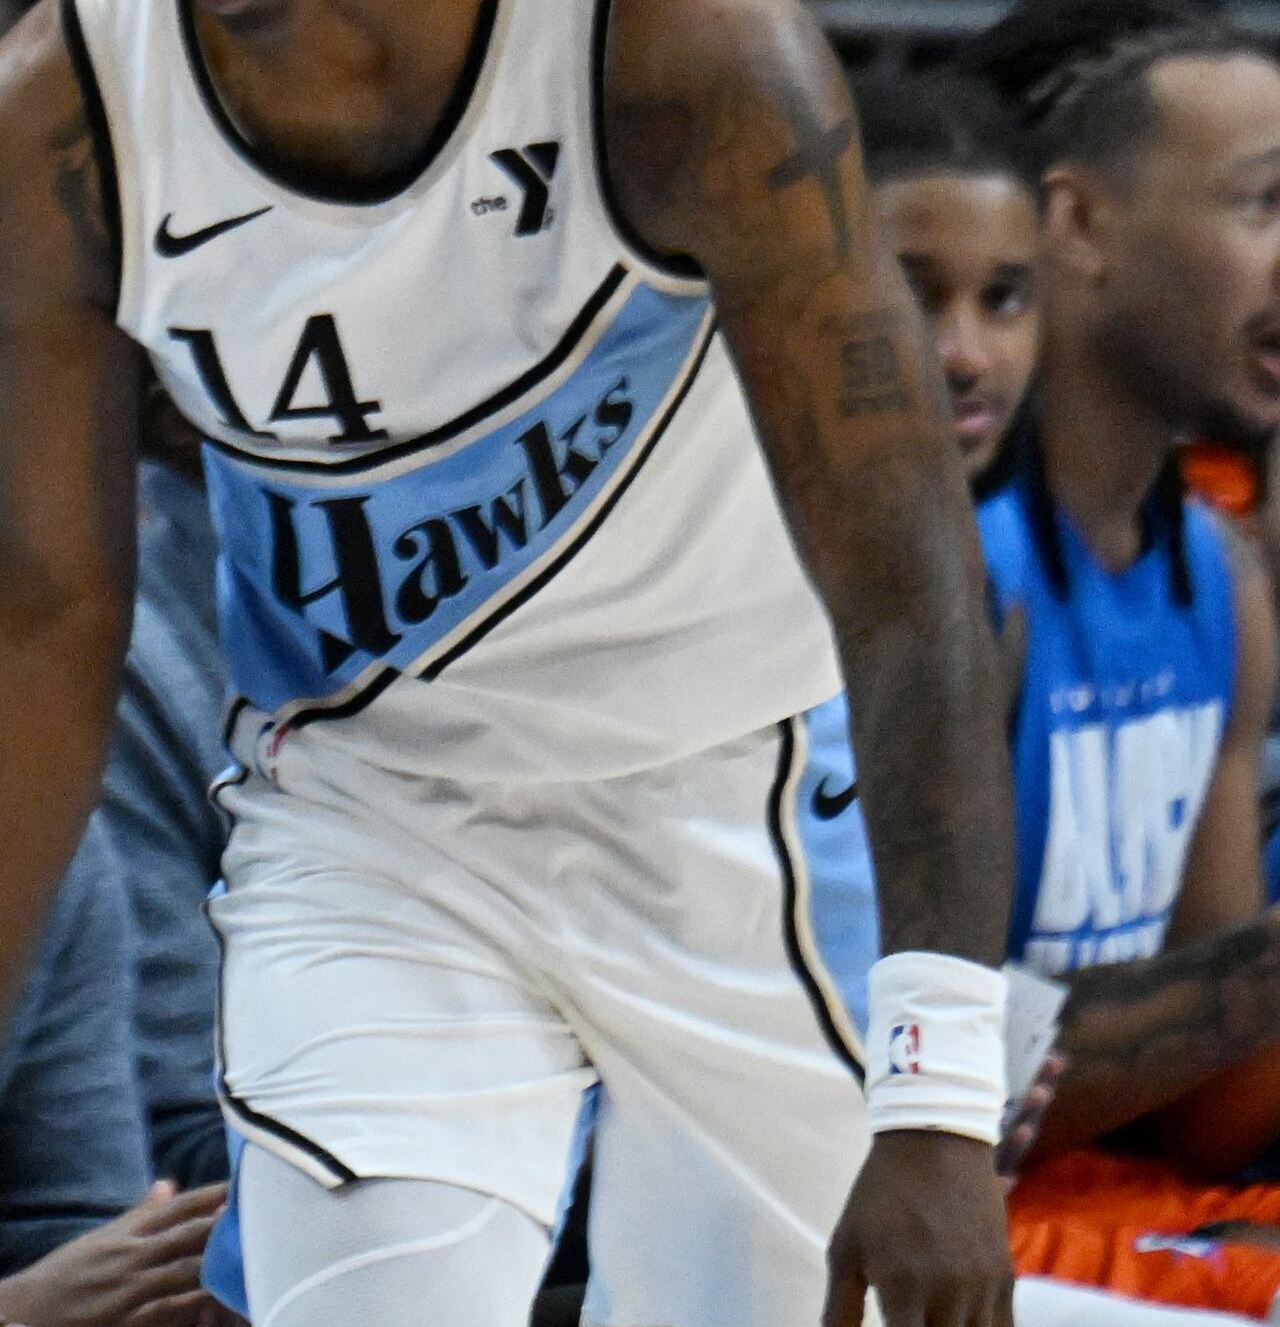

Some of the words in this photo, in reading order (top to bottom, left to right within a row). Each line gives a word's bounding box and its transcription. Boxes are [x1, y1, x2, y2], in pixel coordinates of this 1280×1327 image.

[470, 196, 507, 217] the
[488, 141, 561, 238] Y
[167, 313, 389, 443] 14
[260, 376, 634, 675] Hawks
